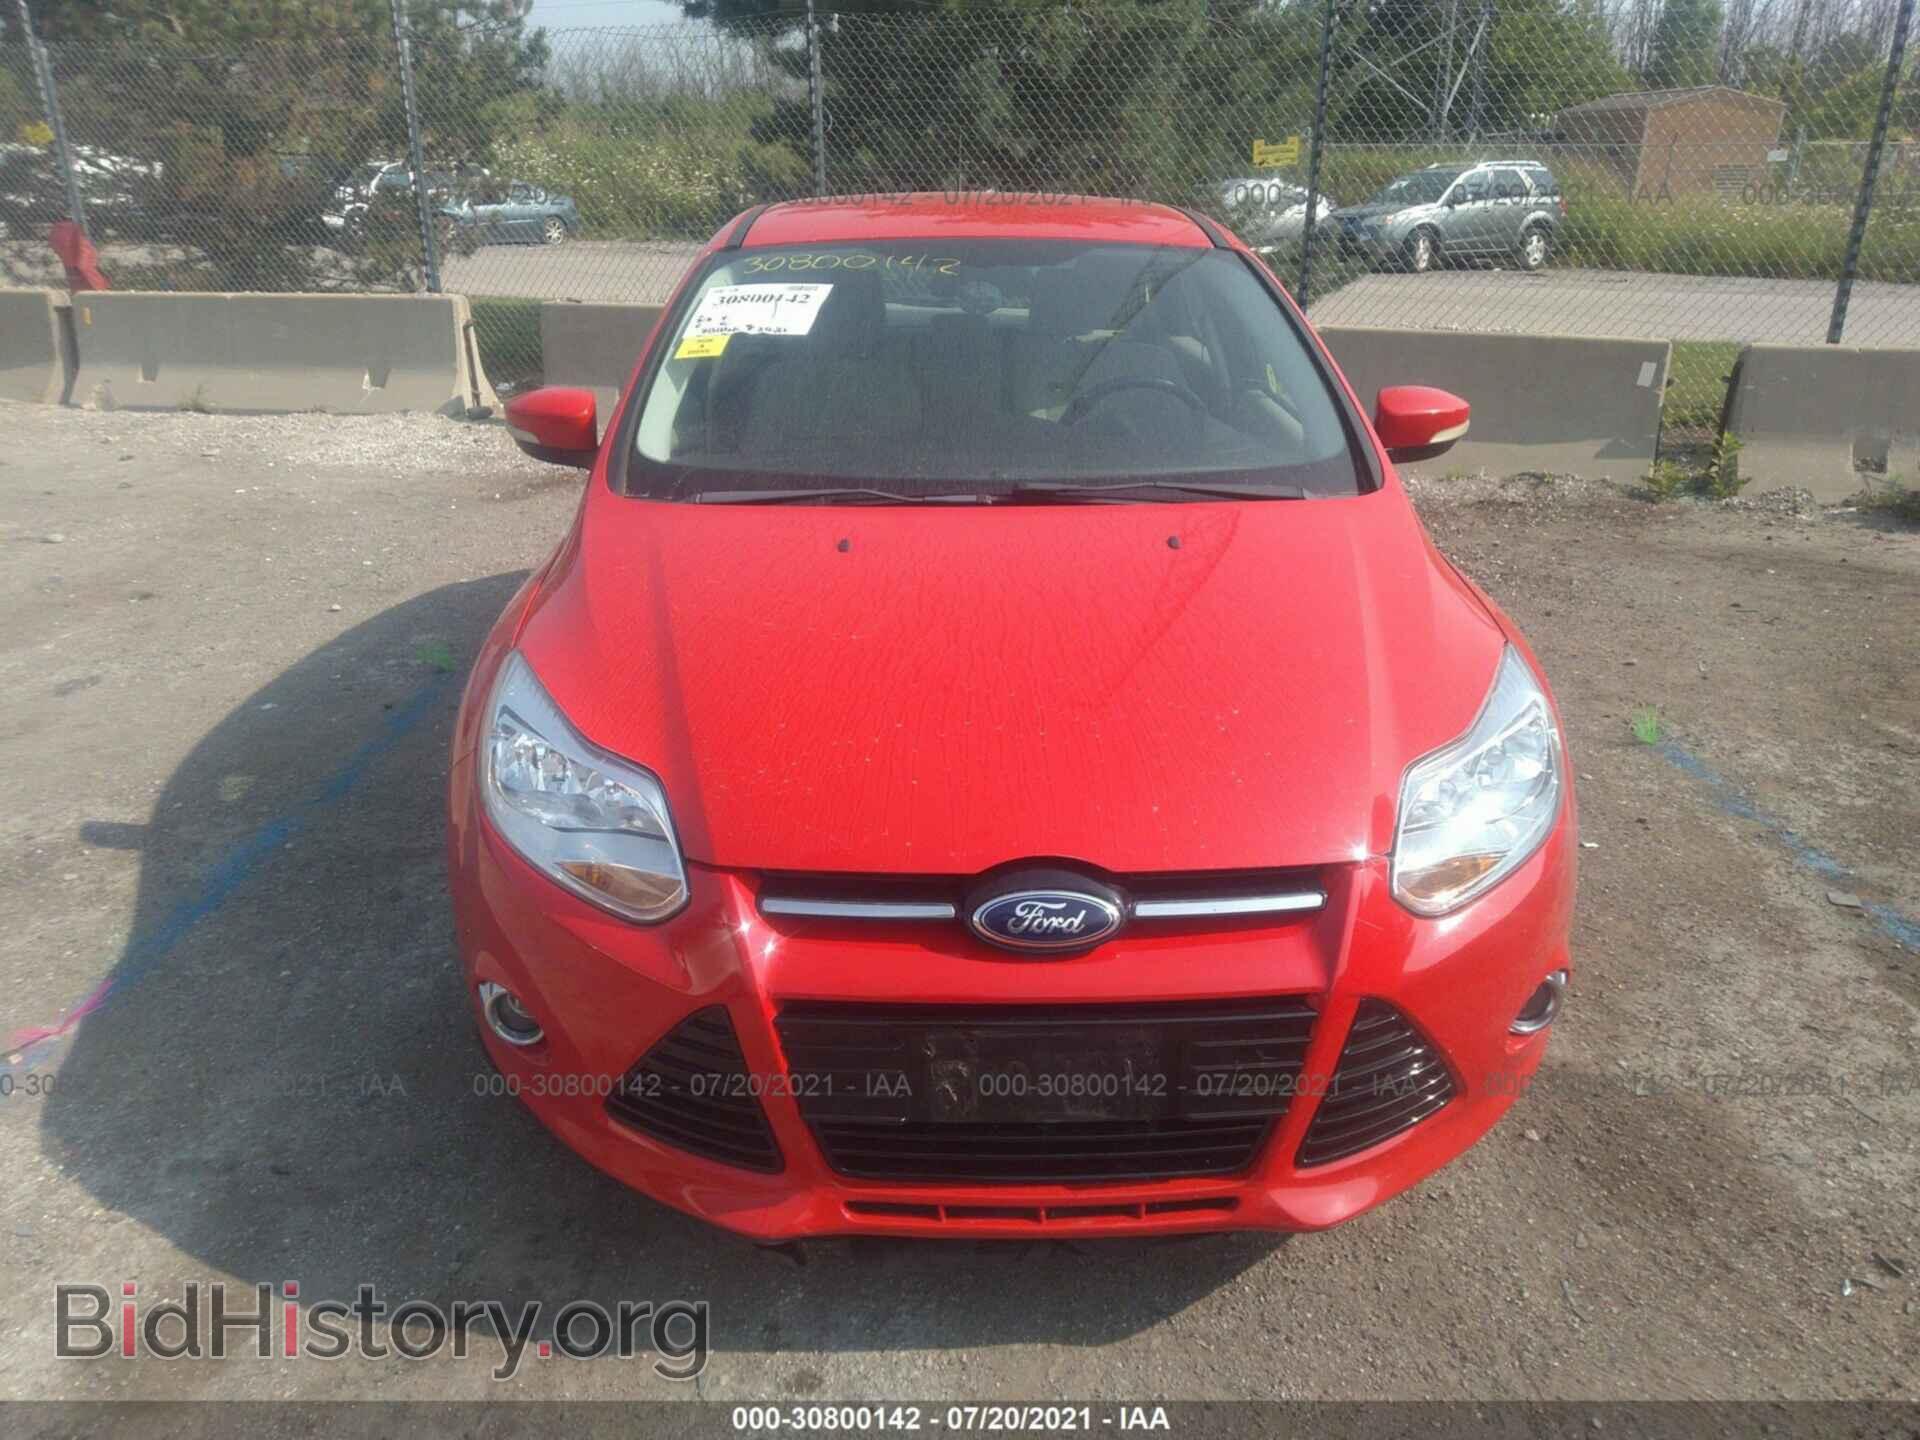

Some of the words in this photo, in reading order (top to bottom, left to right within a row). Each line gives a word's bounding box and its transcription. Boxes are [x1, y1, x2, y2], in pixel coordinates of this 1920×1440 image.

[743, 253, 961, 276] 30800142
[719, 293, 811, 305] 30800142
[1007, 901, 1087, 934] Ford
